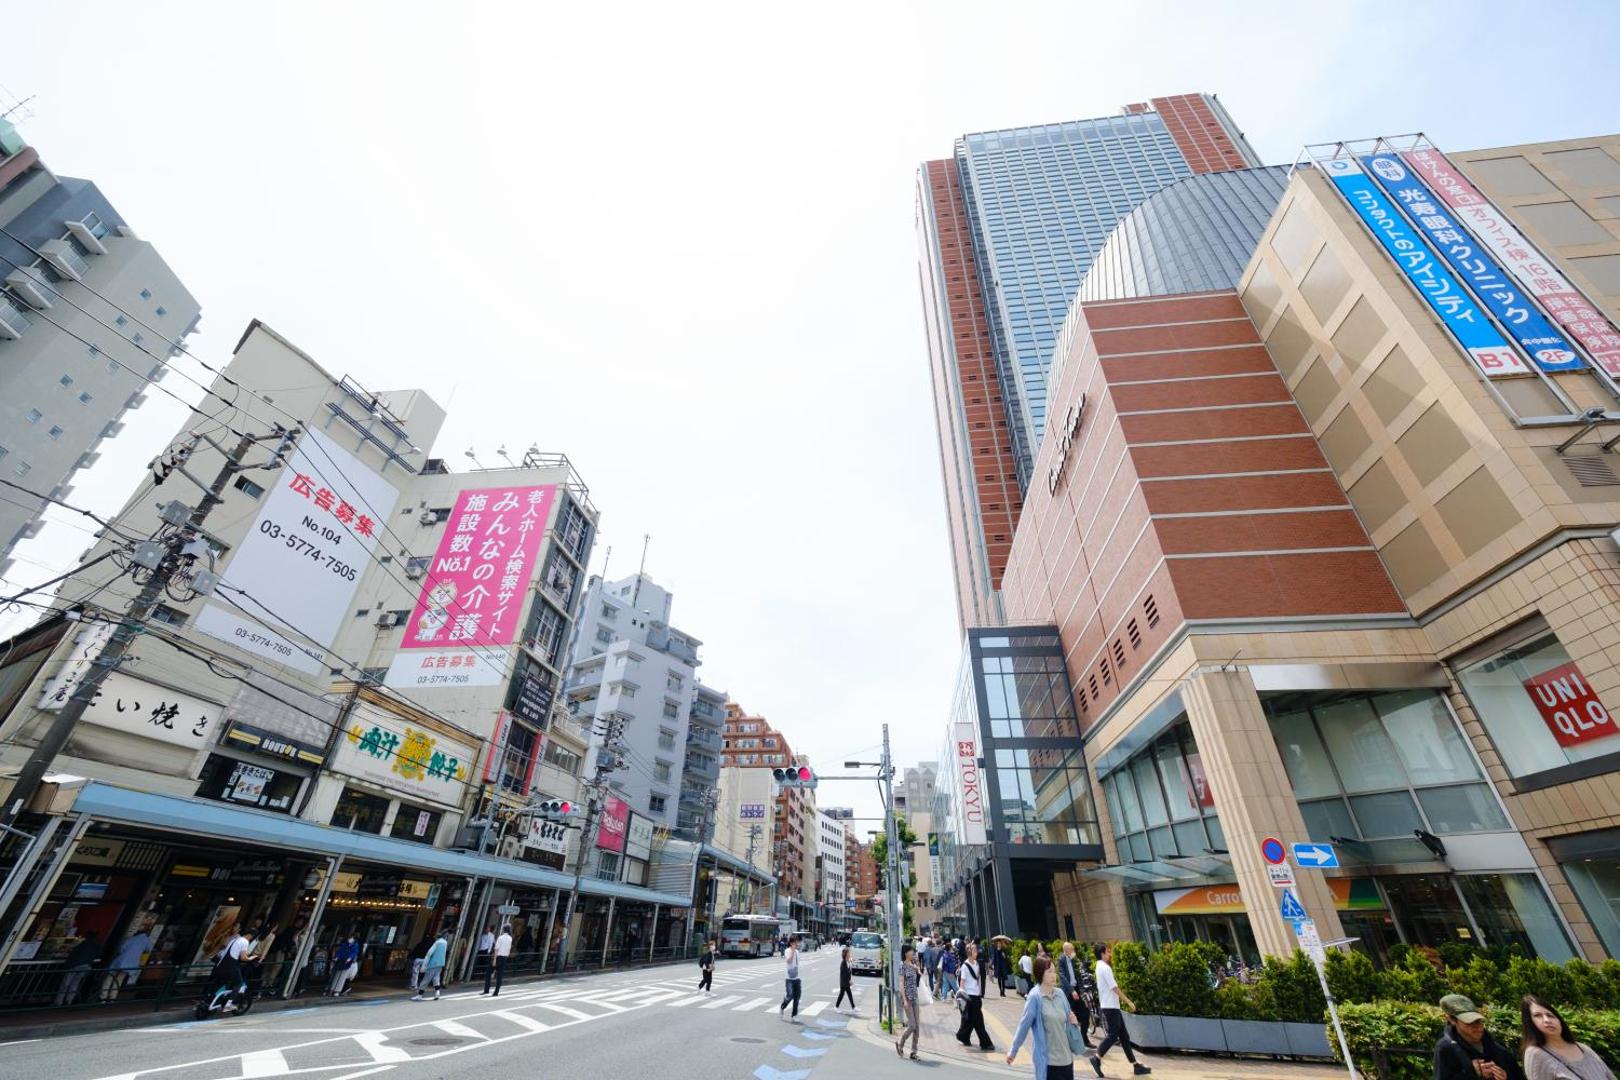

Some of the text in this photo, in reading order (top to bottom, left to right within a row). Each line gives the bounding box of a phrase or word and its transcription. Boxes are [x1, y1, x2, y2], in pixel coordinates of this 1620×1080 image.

[1413, 151, 1473, 204] ほけんの窓口
[1353, 189, 1475, 323] コンタクトのアイシティ
[1477, 352, 1520, 368] B1
[1541, 351, 1566, 362] 2F
[288, 471, 376, 539] 広告募集
[301, 515, 342, 546] No.104
[436, 494, 488, 573] 施設数 No.1
[259, 519, 357, 582] 03-5774-7505
[449, 491, 519, 641] みんなの介護
[488, 489, 544, 640] 老人ホーム検索サイト
[234, 627, 292, 657] 03-5774-7505
[417, 674, 469, 684] 03-5774-7505
[421, 655, 476, 669] 広告募集
[1536, 673, 1588, 707] UNI
[1554, 700, 1609, 738] QLO
[262, 738, 298, 758] DOUTOR
[962, 758, 982, 824] TOKYU
[1206, 891, 1242, 906] Carro
